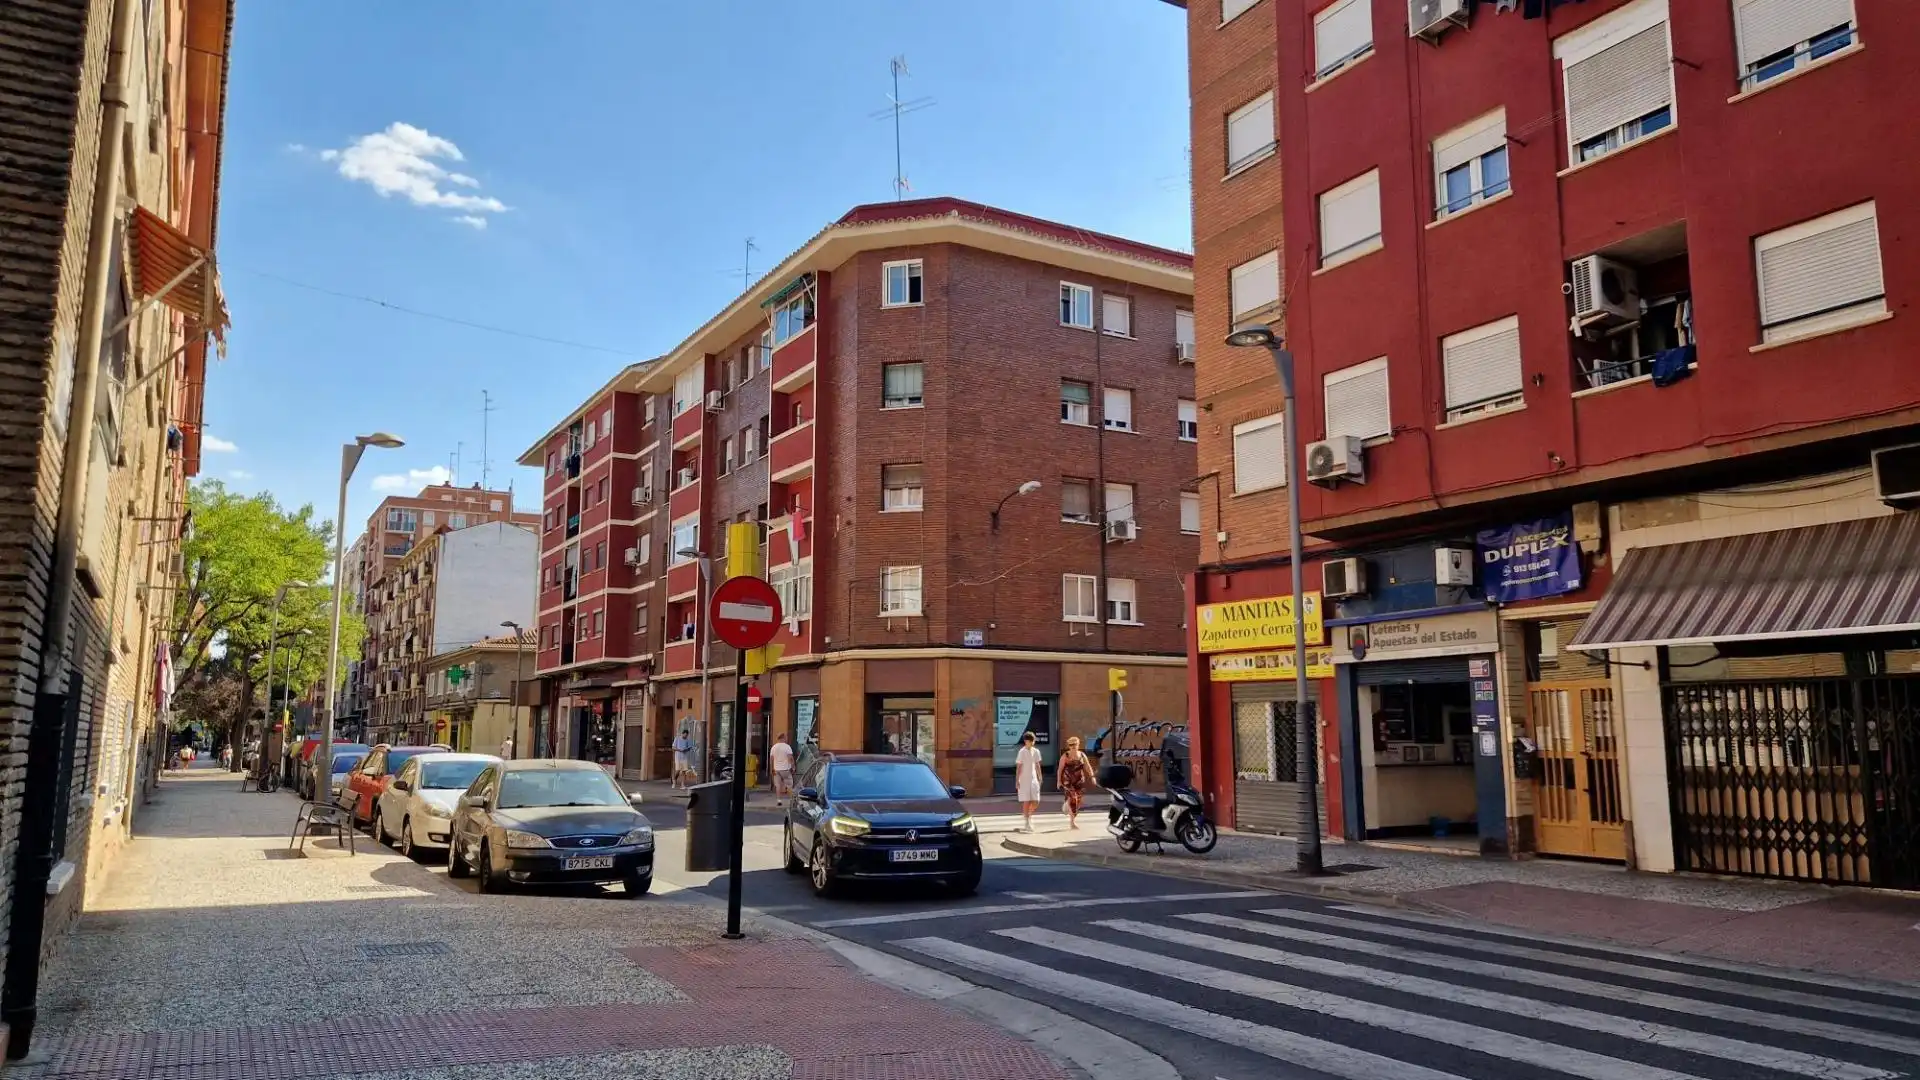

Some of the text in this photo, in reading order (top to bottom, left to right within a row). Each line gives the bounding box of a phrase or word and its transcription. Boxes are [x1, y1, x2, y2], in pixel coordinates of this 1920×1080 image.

[1484, 533, 1569, 563] DUPLEX
[1222, 599, 1291, 622] MANITAS
[1201, 621, 1318, 643] Zapatero y Cerraro
[1373, 628, 1477, 650] Apuestas del Estado
[1414, 623, 1420, 634] y
[568, 858, 611, 869] 8715 CKL
[895, 850, 937, 860] 3749 MMG
